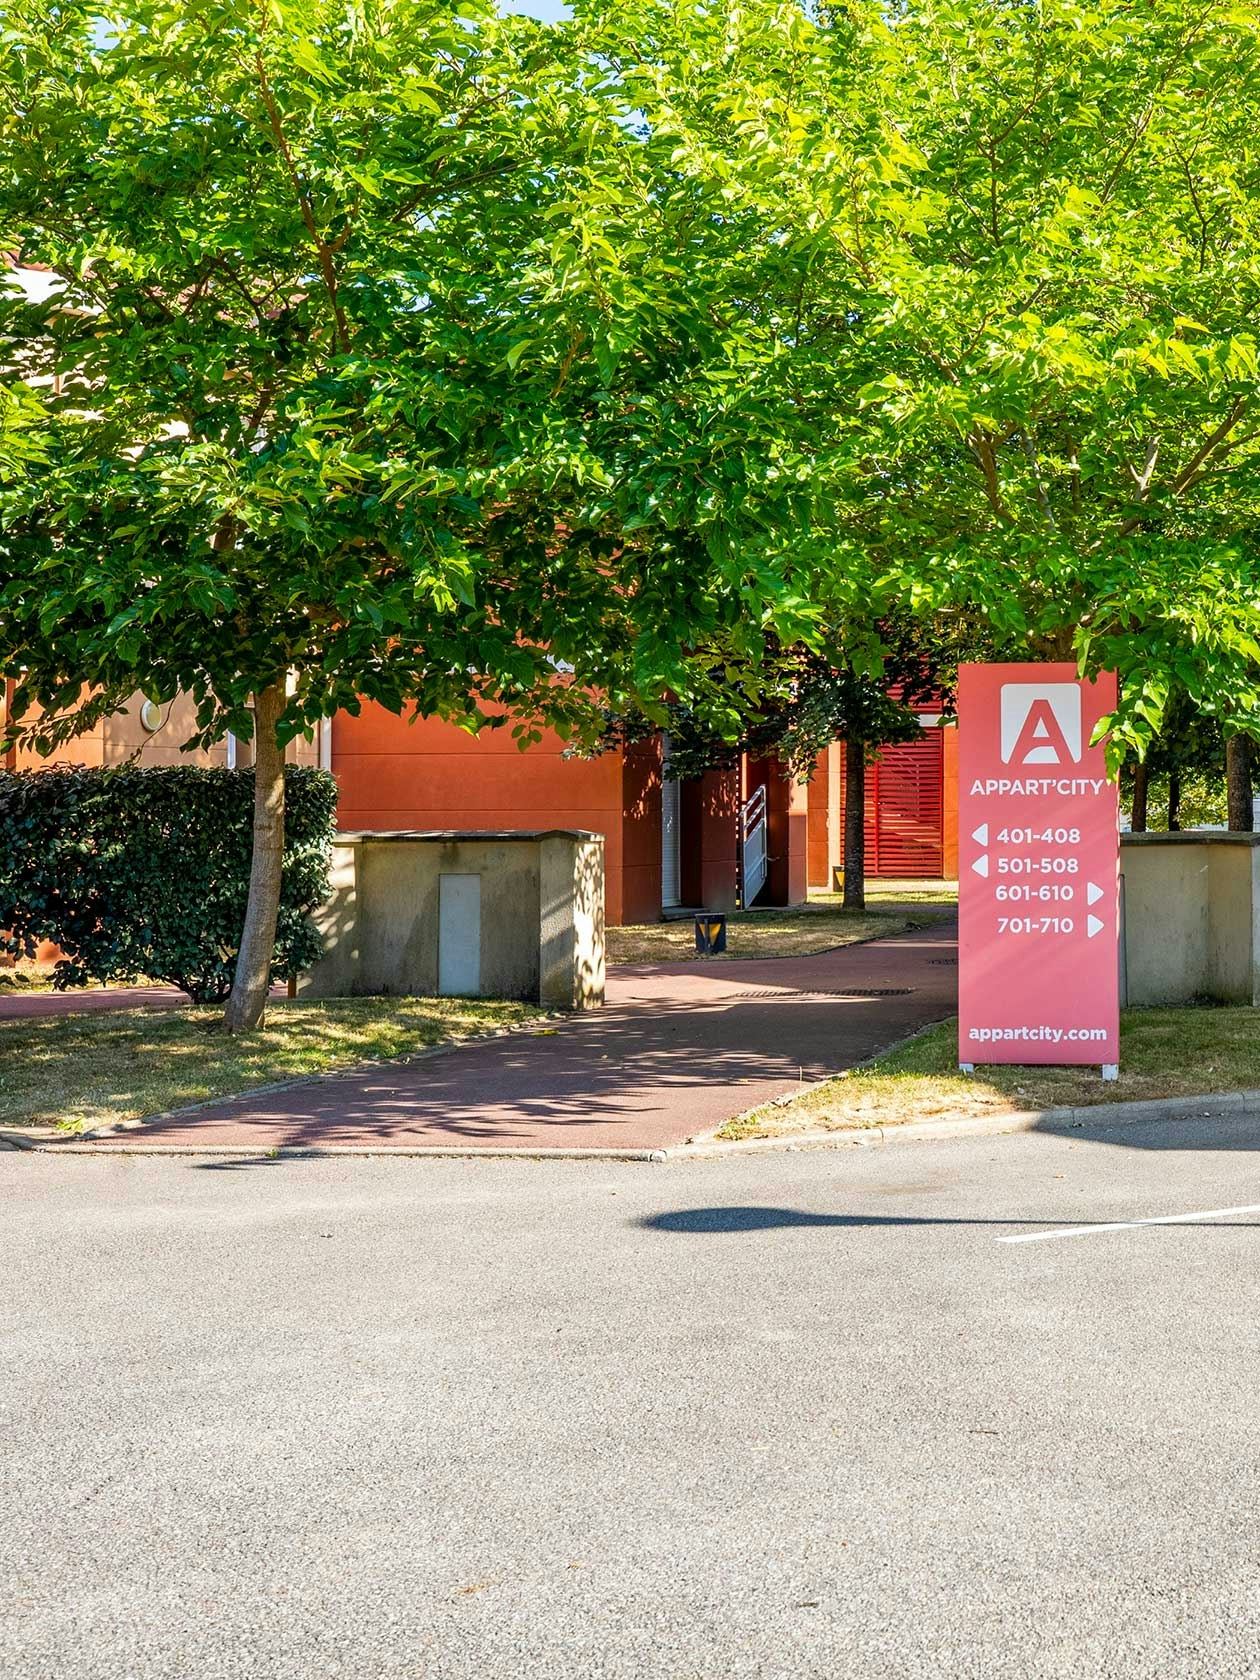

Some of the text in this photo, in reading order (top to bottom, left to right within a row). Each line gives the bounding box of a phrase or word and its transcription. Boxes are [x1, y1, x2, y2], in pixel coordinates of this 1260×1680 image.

[970, 779, 1104, 796] APPART'CITY
[996, 827, 1081, 844] 401-408
[997, 857, 1079, 874] 501-508
[995, 884, 1074, 901] 601-610
[997, 917, 1074, 934] 701-710
[969, 1025, 1107, 1042] appartcity.com
